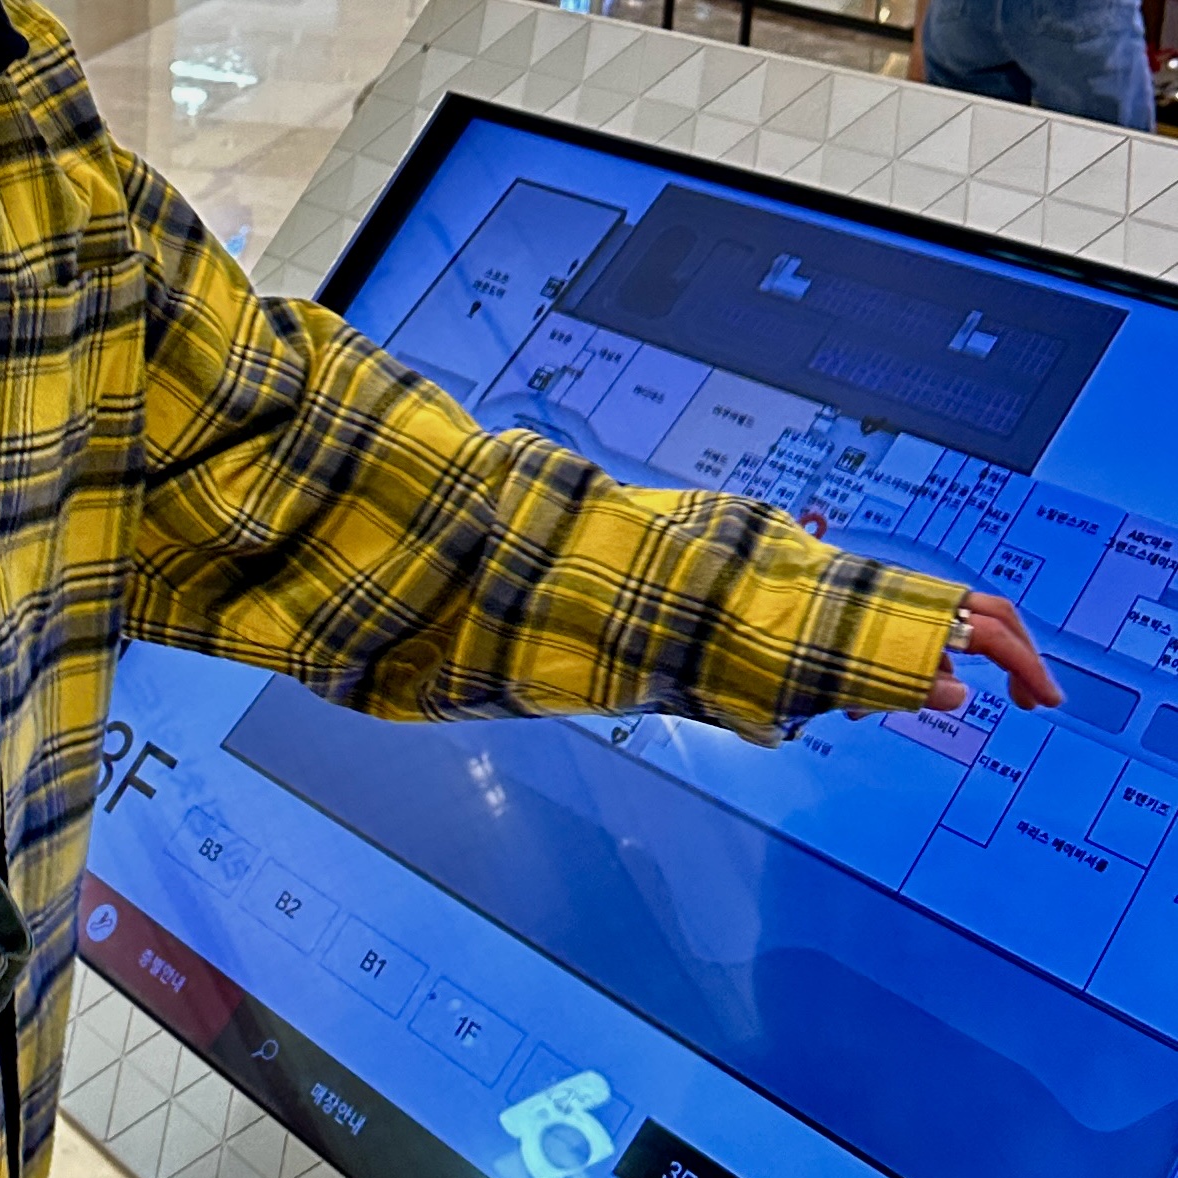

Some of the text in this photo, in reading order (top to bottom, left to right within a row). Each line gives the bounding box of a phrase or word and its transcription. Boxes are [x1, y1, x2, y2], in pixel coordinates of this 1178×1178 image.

[987, 505, 1010, 523] MLB
[1036, 504, 1099, 535] 뉴발란스키즈
[1104, 536, 1178, 570] 그랜드스테이지
[1127, 529, 1173, 552] ABC마트
[1128, 610, 1172, 636] 아트박스
[981, 691, 1004, 709] SAG
[977, 755, 1022, 783] 디트로네
[1016, 820, 1050, 845] 마리스
[198, 837, 223, 862] B3
[274, 889, 304, 919] B2
[137, 948, 188, 994] 층별안내
[358, 948, 389, 980] B1
[455, 1015, 483, 1042] 1F
[310, 1082, 368, 1137] 매장안내
